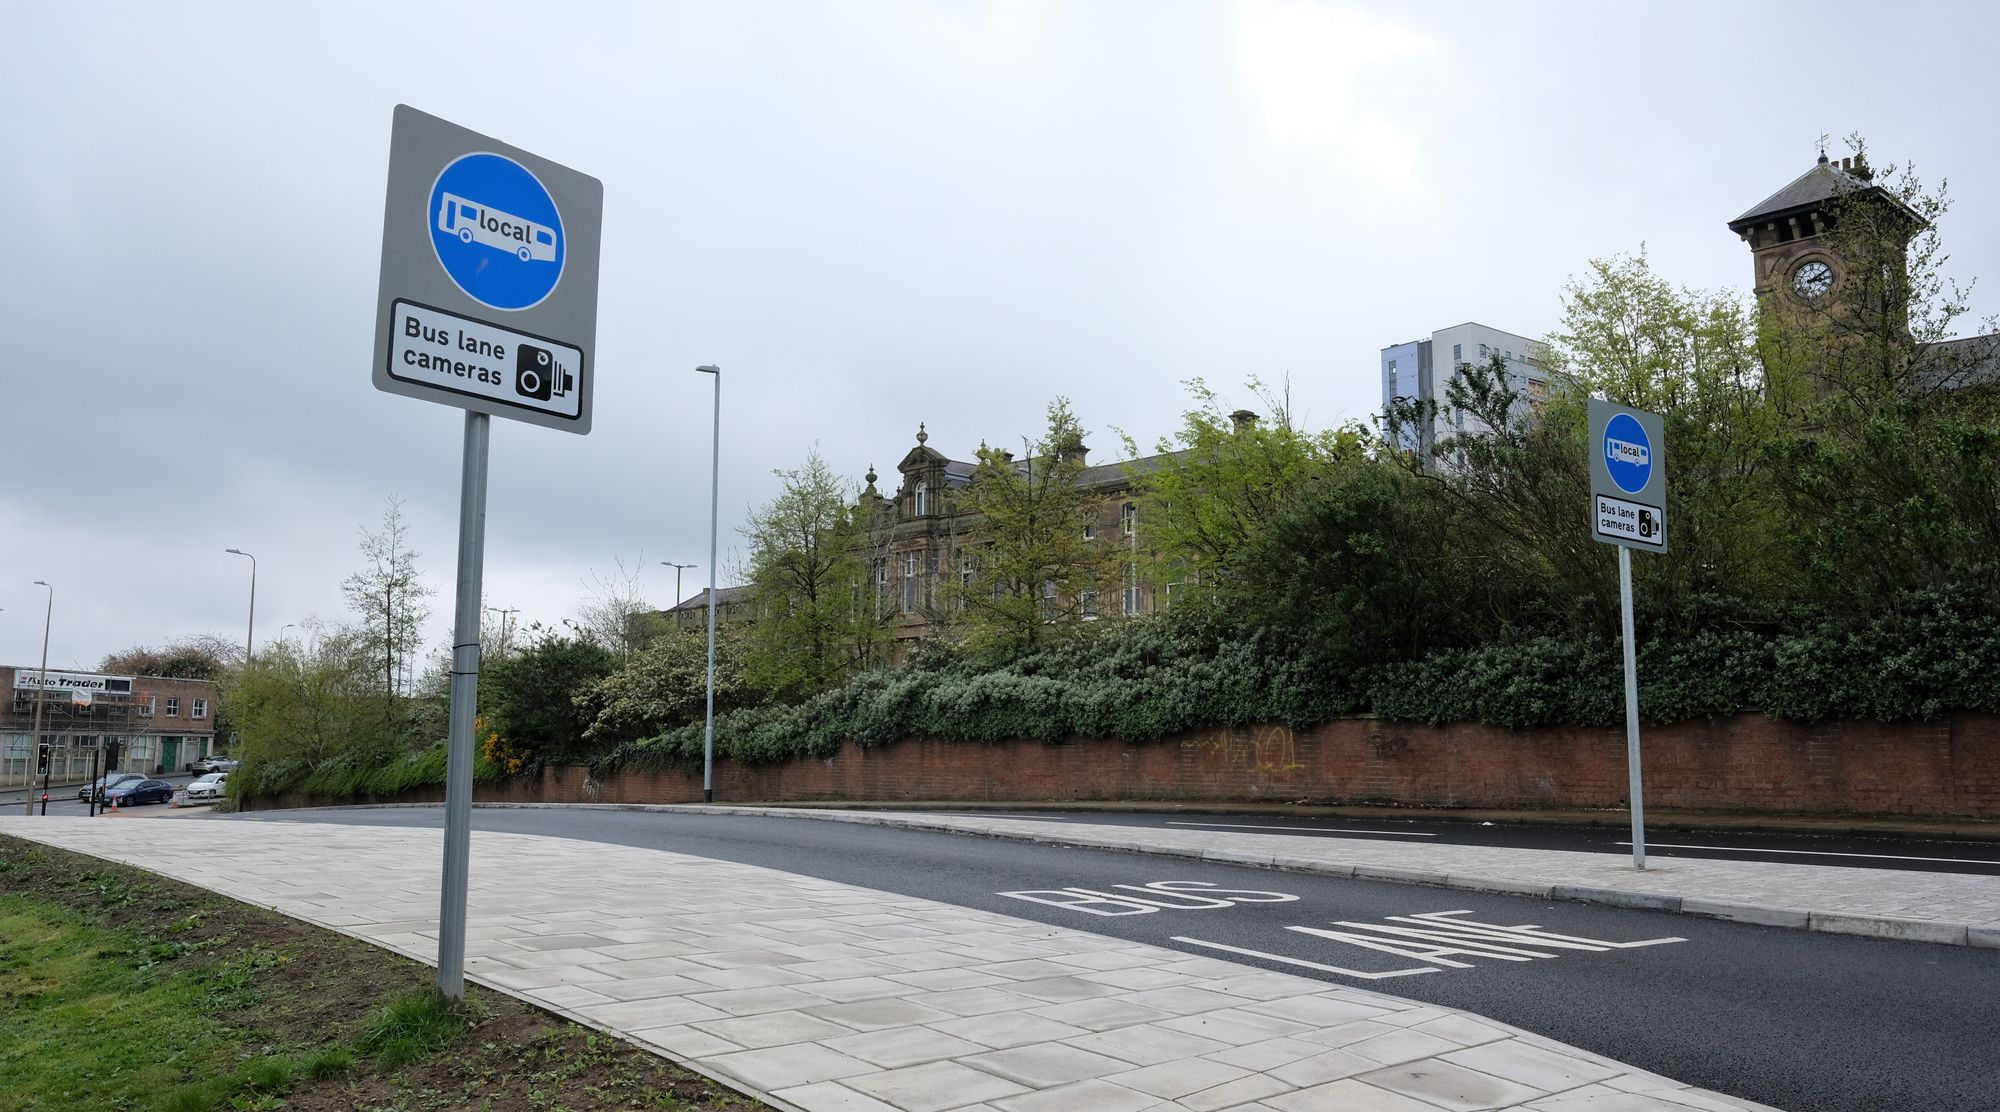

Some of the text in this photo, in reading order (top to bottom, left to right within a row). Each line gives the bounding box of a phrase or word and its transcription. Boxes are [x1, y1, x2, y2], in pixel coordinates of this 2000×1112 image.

[479, 209, 532, 244] local
[405, 316, 506, 360] Bus lane
[403, 348, 502, 386] cameras
[1620, 442, 1640, 457] local
[1600, 502, 1635, 519] Bus lane
[1601, 518, 1635, 533] cameras
[59, 678, 104, 688] Trader
[994, 881, 1300, 917] BUS
[1169, 909, 1690, 980] LANE
